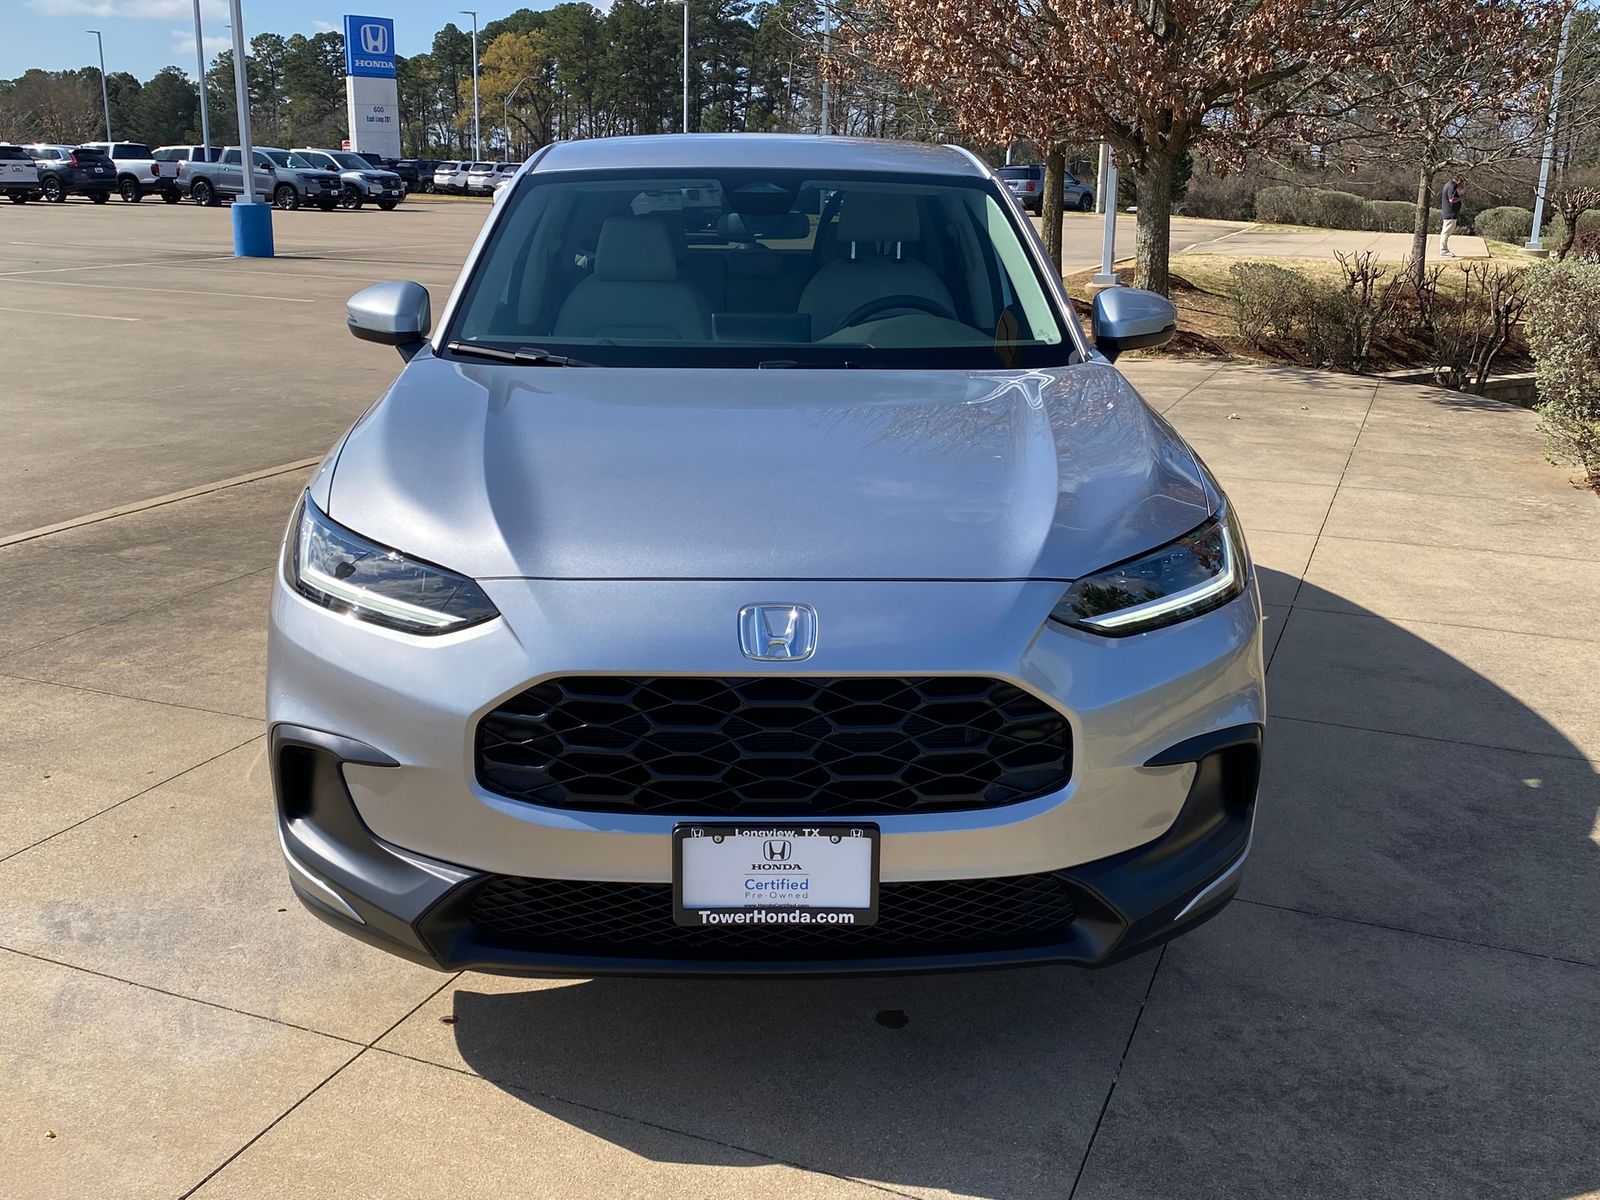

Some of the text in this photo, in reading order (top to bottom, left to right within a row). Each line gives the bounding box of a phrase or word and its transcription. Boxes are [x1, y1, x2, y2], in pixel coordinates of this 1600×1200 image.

[355, 60, 395, 68] HONDA
[802, 828, 820, 837] TX
[744, 878, 809, 890] Certified
[745, 891, 808, 899] Pre-Owned
[699, 910, 855, 924] TowerHonda.com
